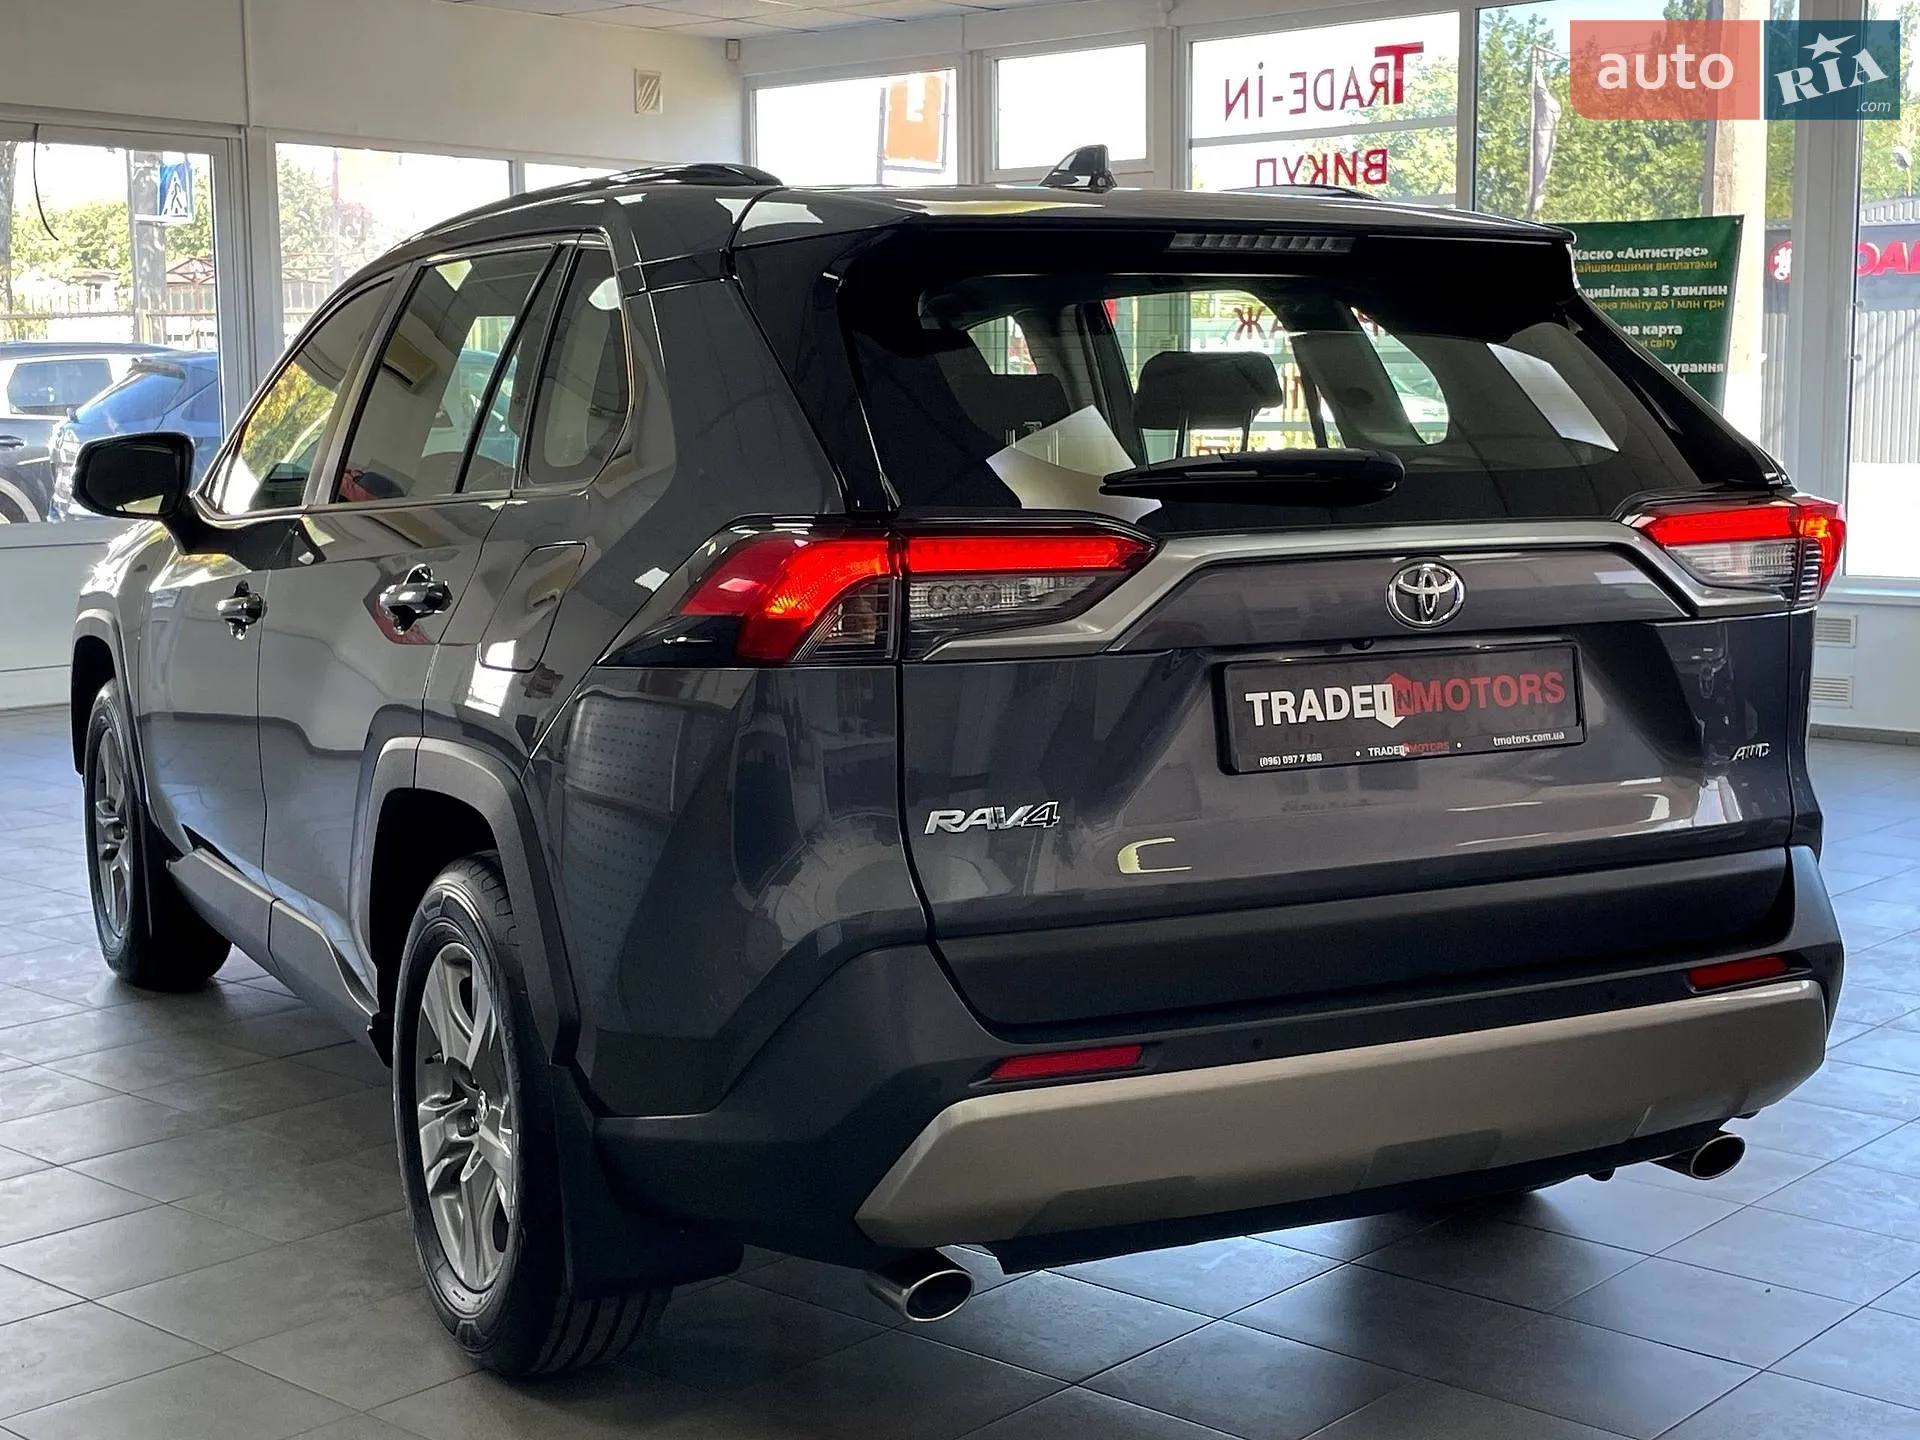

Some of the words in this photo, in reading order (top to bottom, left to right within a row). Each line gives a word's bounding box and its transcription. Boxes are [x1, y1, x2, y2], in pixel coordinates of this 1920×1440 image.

[1617, 246, 1709, 260] «Антистрес»
[1656, 260, 1717, 272] виплатами
[1583, 284, 1640, 299] цивілка
[1642, 287, 1658, 297] за
[1661, 286, 1670, 297] 5
[1672, 285, 1728, 297] хвилин
[1654, 300, 1668, 311] до
[1677, 299, 1700, 309] млн
[1703, 298, 1725, 311] грн
[1643, 325, 1682, 338] карта
[1650, 338, 1677, 350] світу
[1493, 731, 1565, 748] tmotors.com.ua
[924, 800, 1060, 834] RAV4
